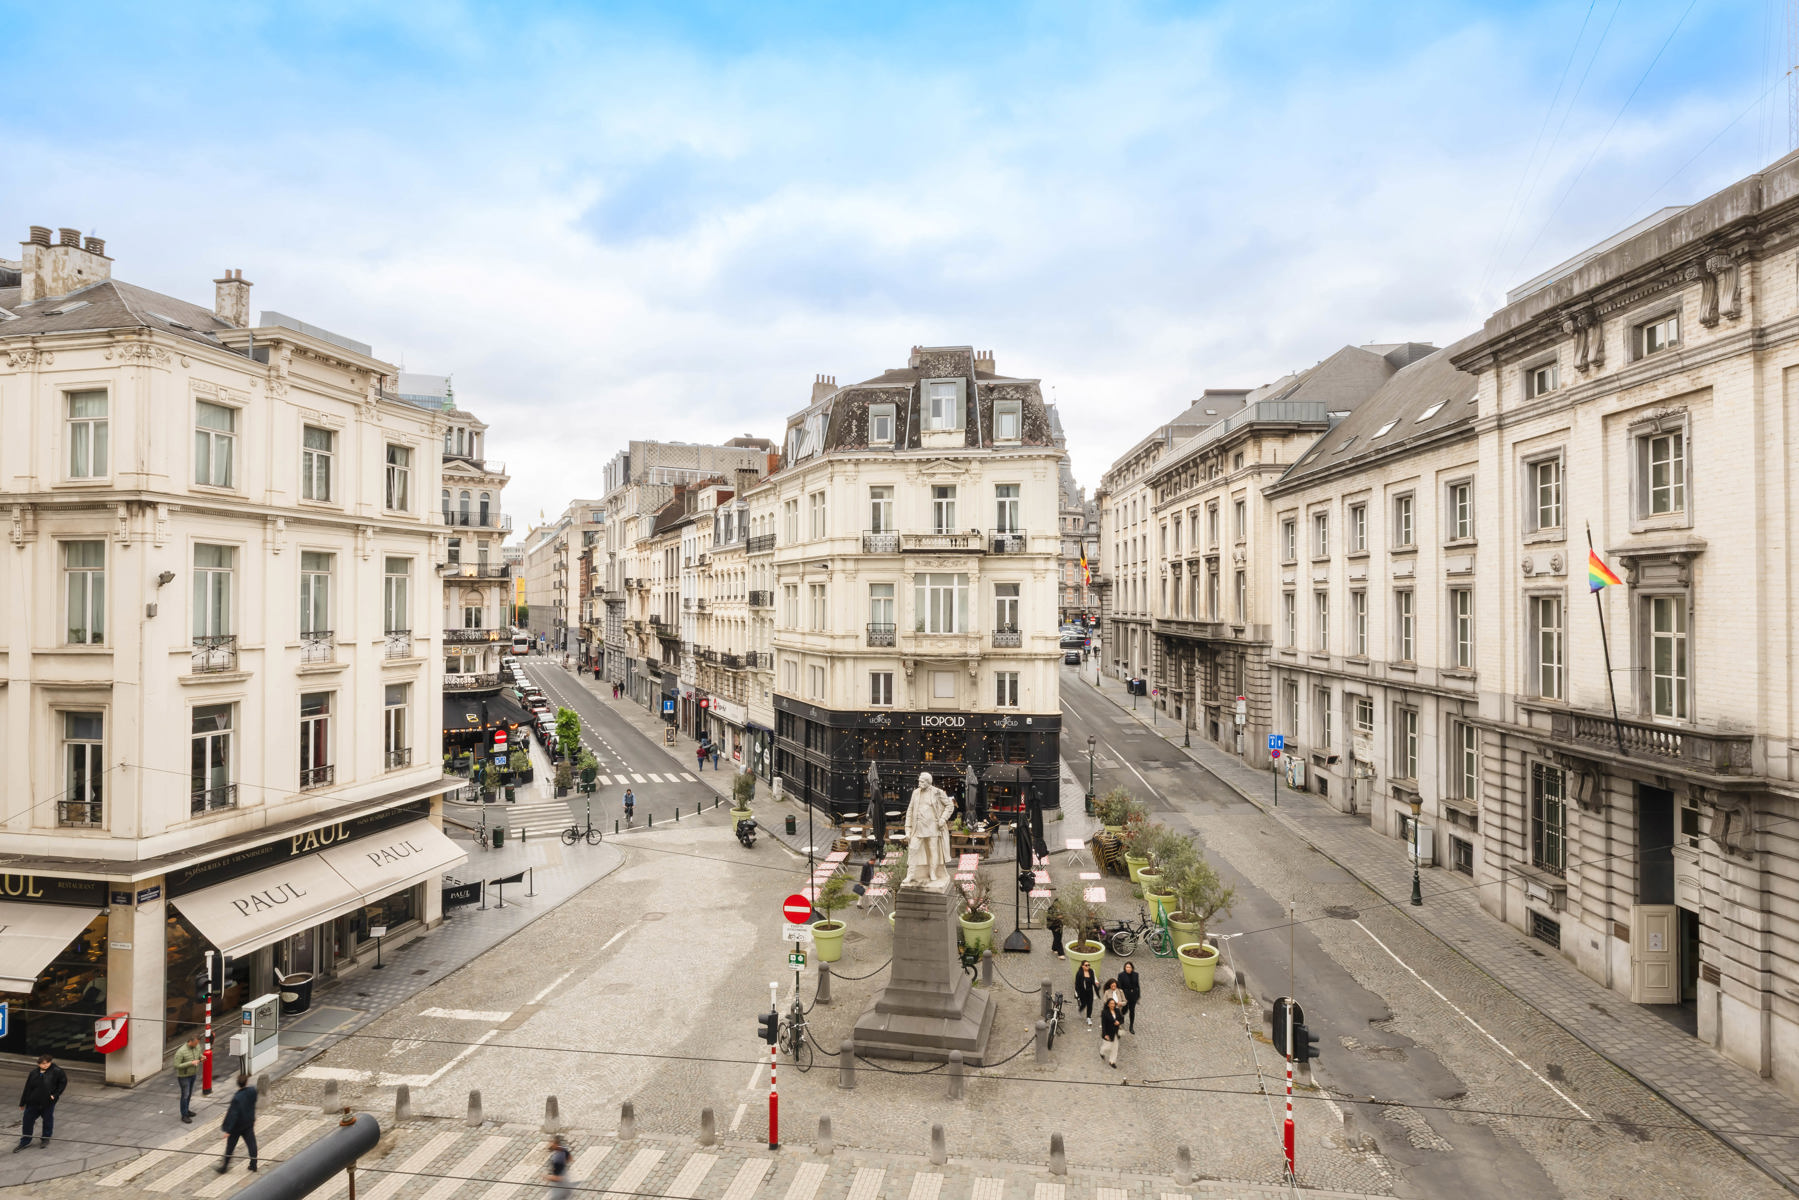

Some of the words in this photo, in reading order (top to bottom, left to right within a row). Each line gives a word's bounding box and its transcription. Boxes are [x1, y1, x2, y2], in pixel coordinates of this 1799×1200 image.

[921, 716, 965, 726] LEOPOLD
[290, 822, 350, 856] PAUL
[366, 840, 423, 867] PAUL
[232, 882, 307, 916] PAUL
[450, 889, 471, 899] PAUL
